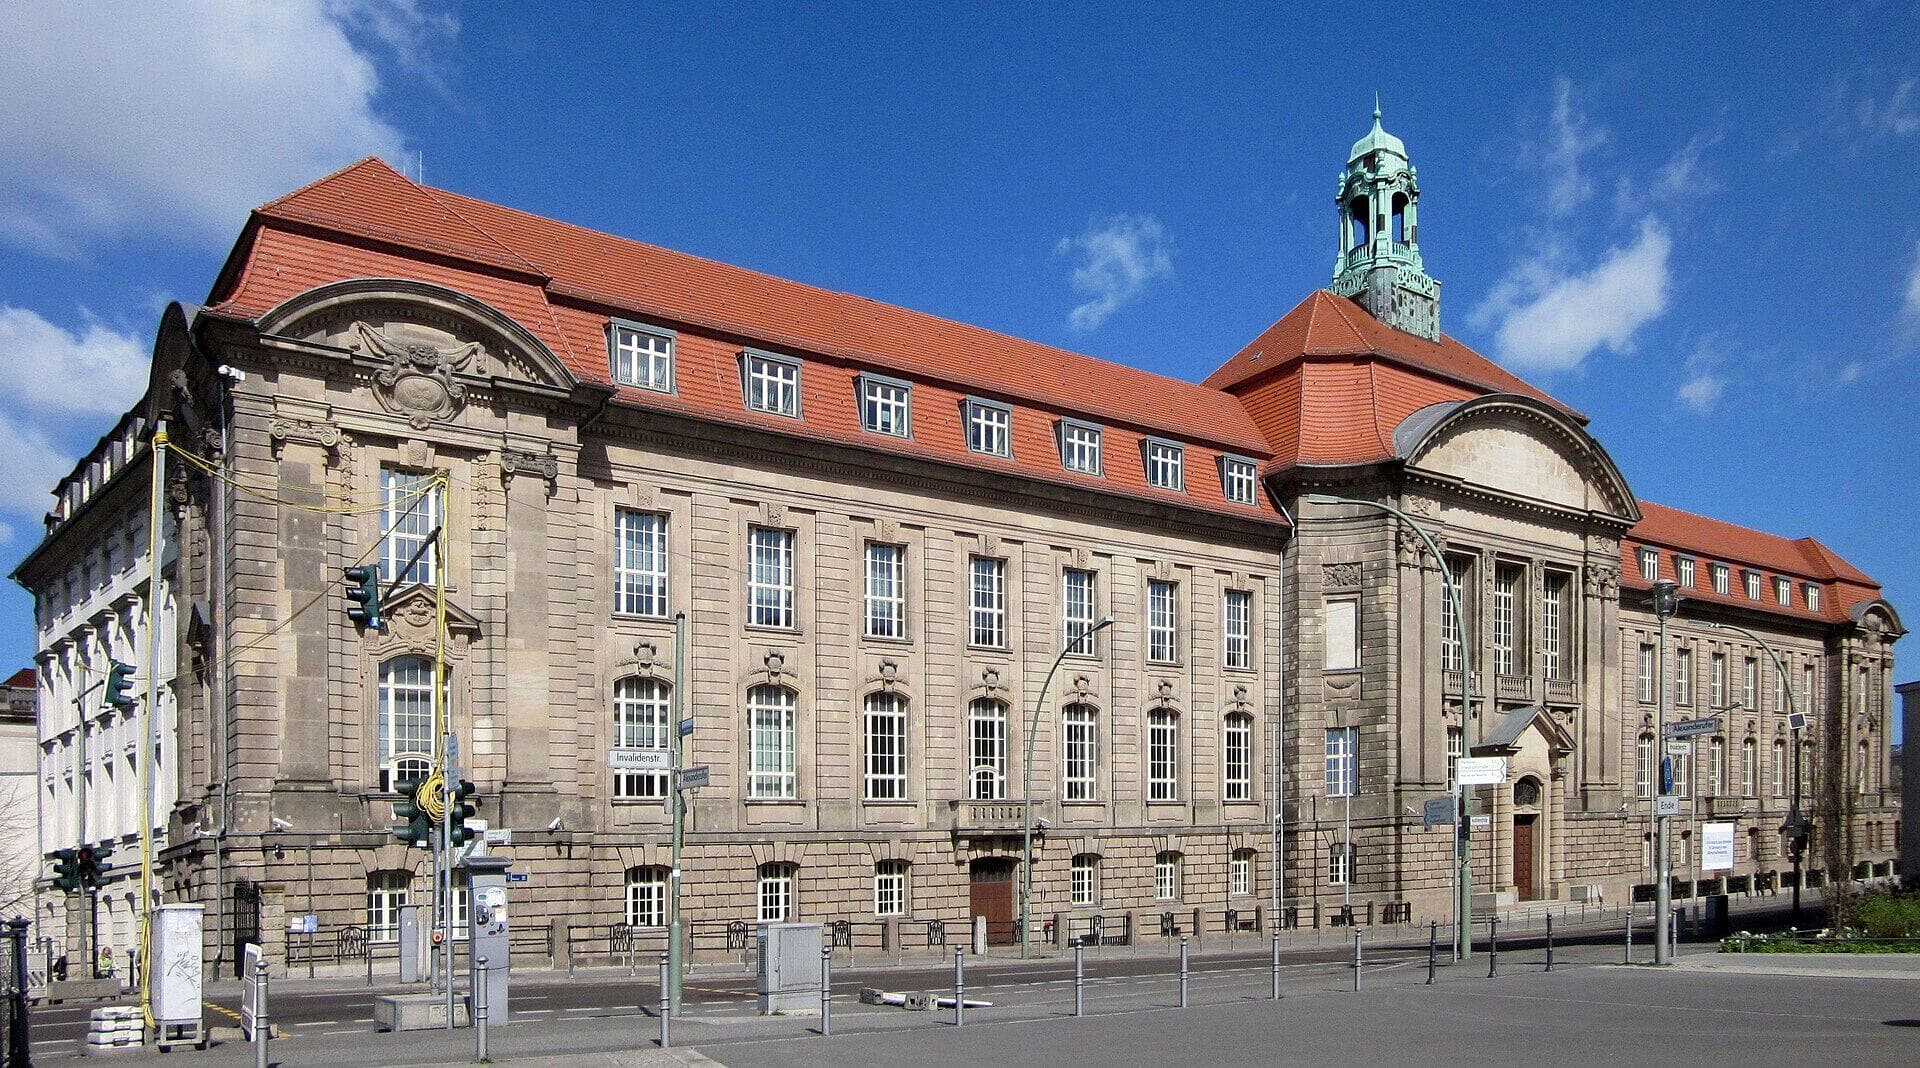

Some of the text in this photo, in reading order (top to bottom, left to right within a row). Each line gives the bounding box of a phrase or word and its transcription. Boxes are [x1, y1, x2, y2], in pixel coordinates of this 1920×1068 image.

[1673, 721, 1714, 732] Alexanderufer
[616, 752, 662, 763] Invalidenstr.
[1660, 801, 1675, 811] Ende
